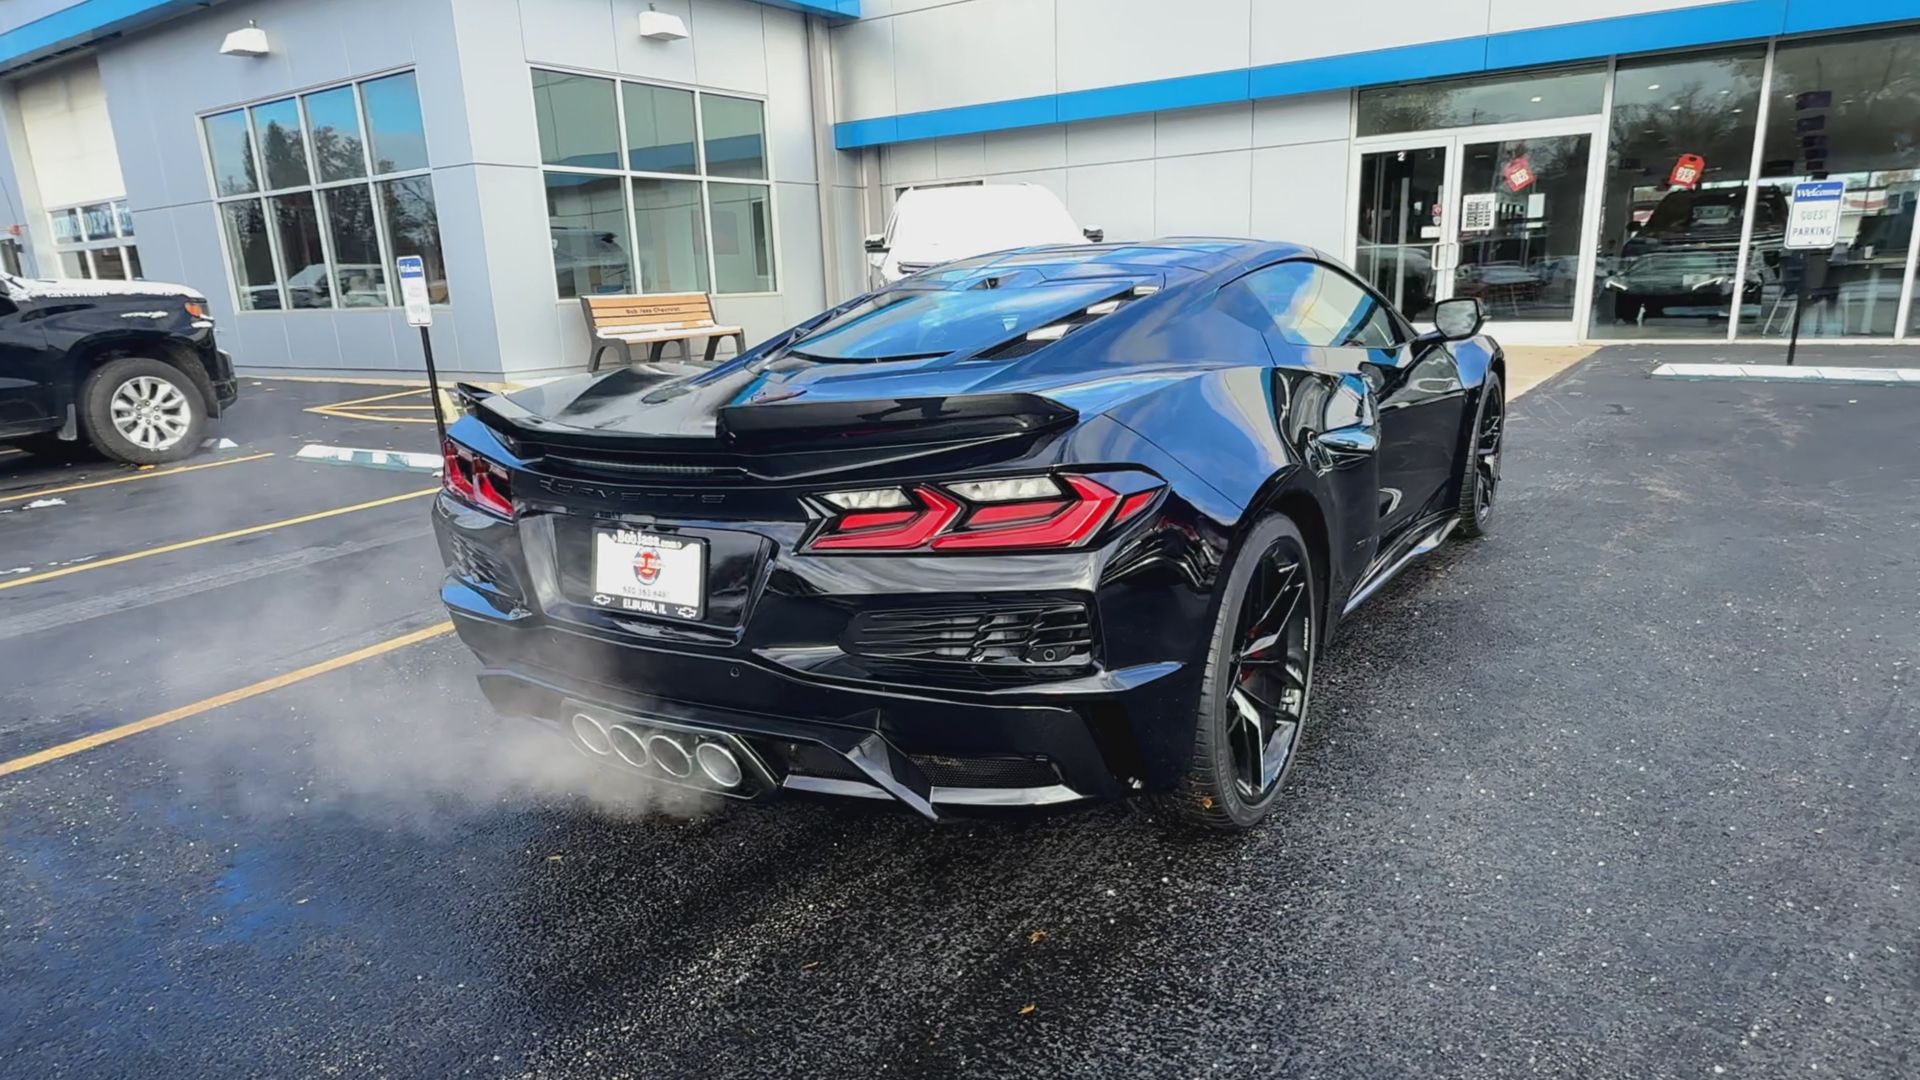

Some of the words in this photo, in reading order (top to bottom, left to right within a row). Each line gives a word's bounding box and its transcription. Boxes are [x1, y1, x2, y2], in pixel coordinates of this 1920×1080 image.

[1796, 184, 1842, 198] Welcome
[1792, 226, 1832, 236] PARKING
[617, 529, 637, 545] Bob
